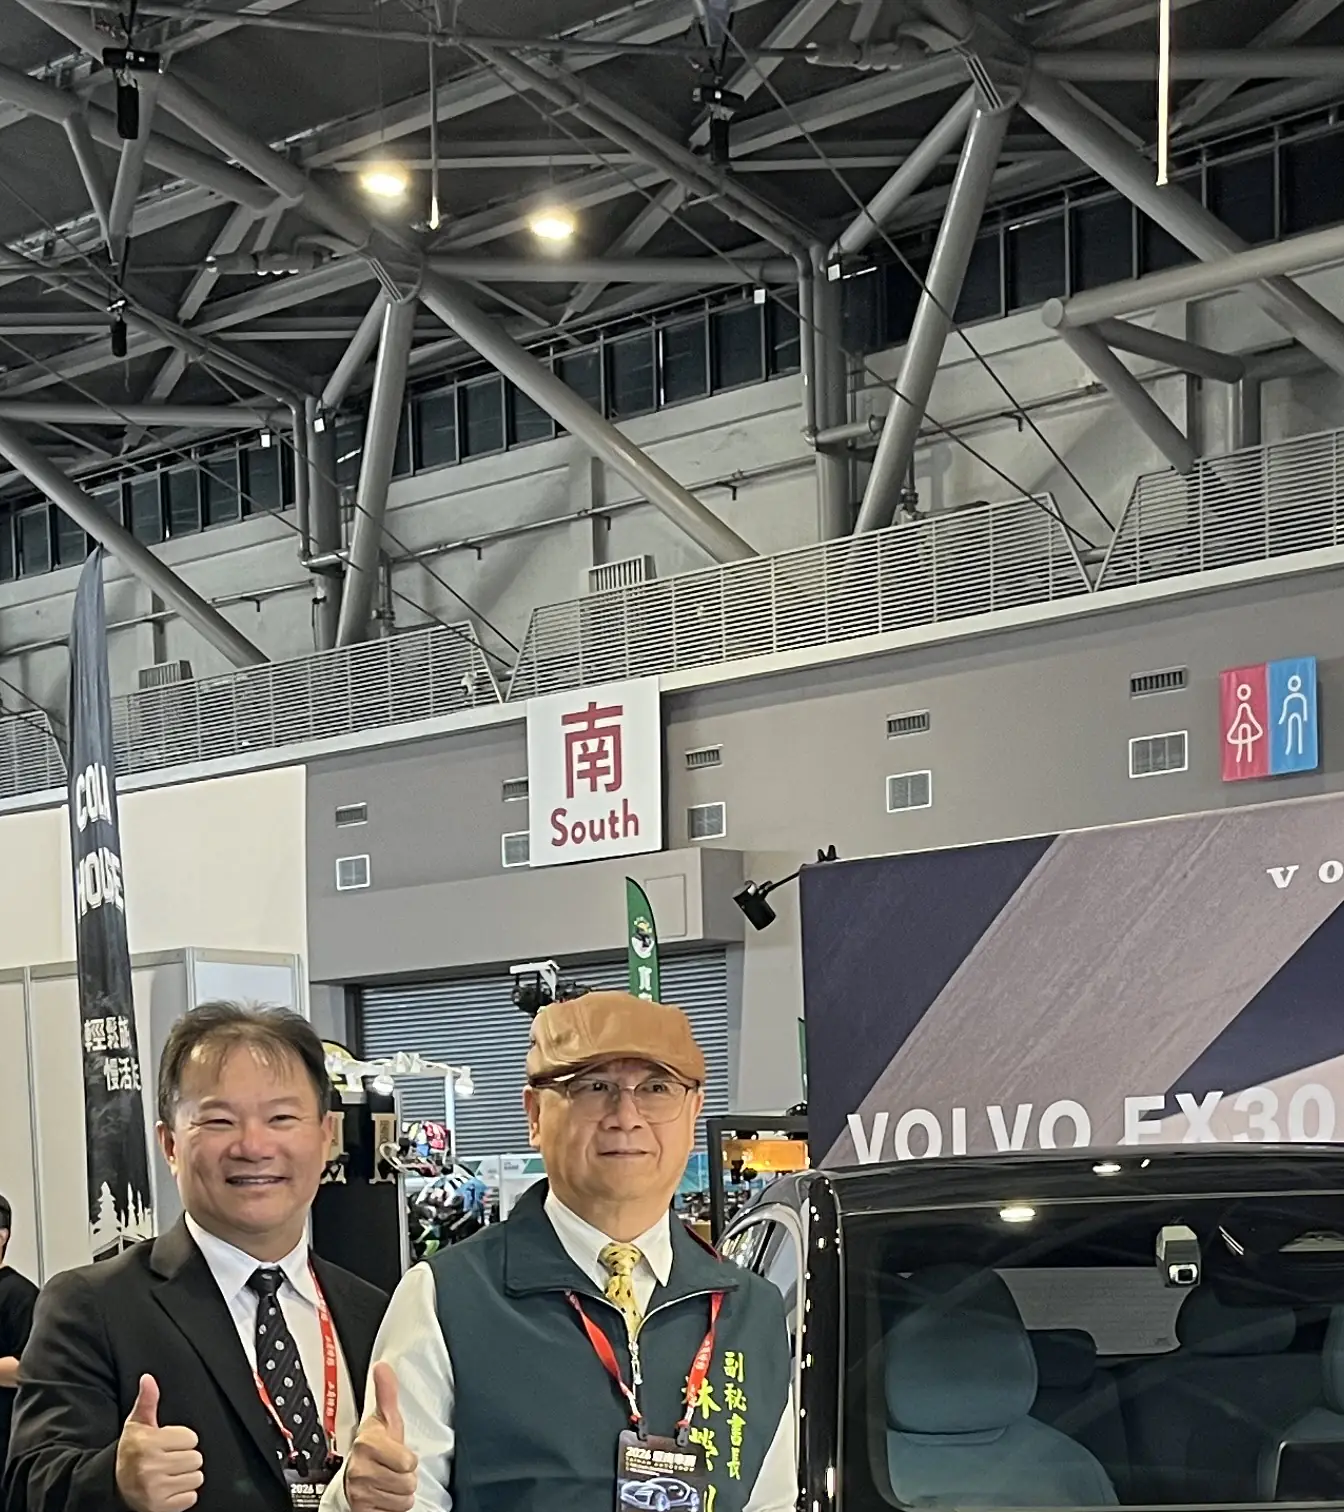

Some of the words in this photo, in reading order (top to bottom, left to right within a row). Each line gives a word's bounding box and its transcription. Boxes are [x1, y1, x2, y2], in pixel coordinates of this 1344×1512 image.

[561, 702, 623, 798] 南
[551, 798, 639, 847] South
[723, 1351, 747, 1480] 副秘書長
